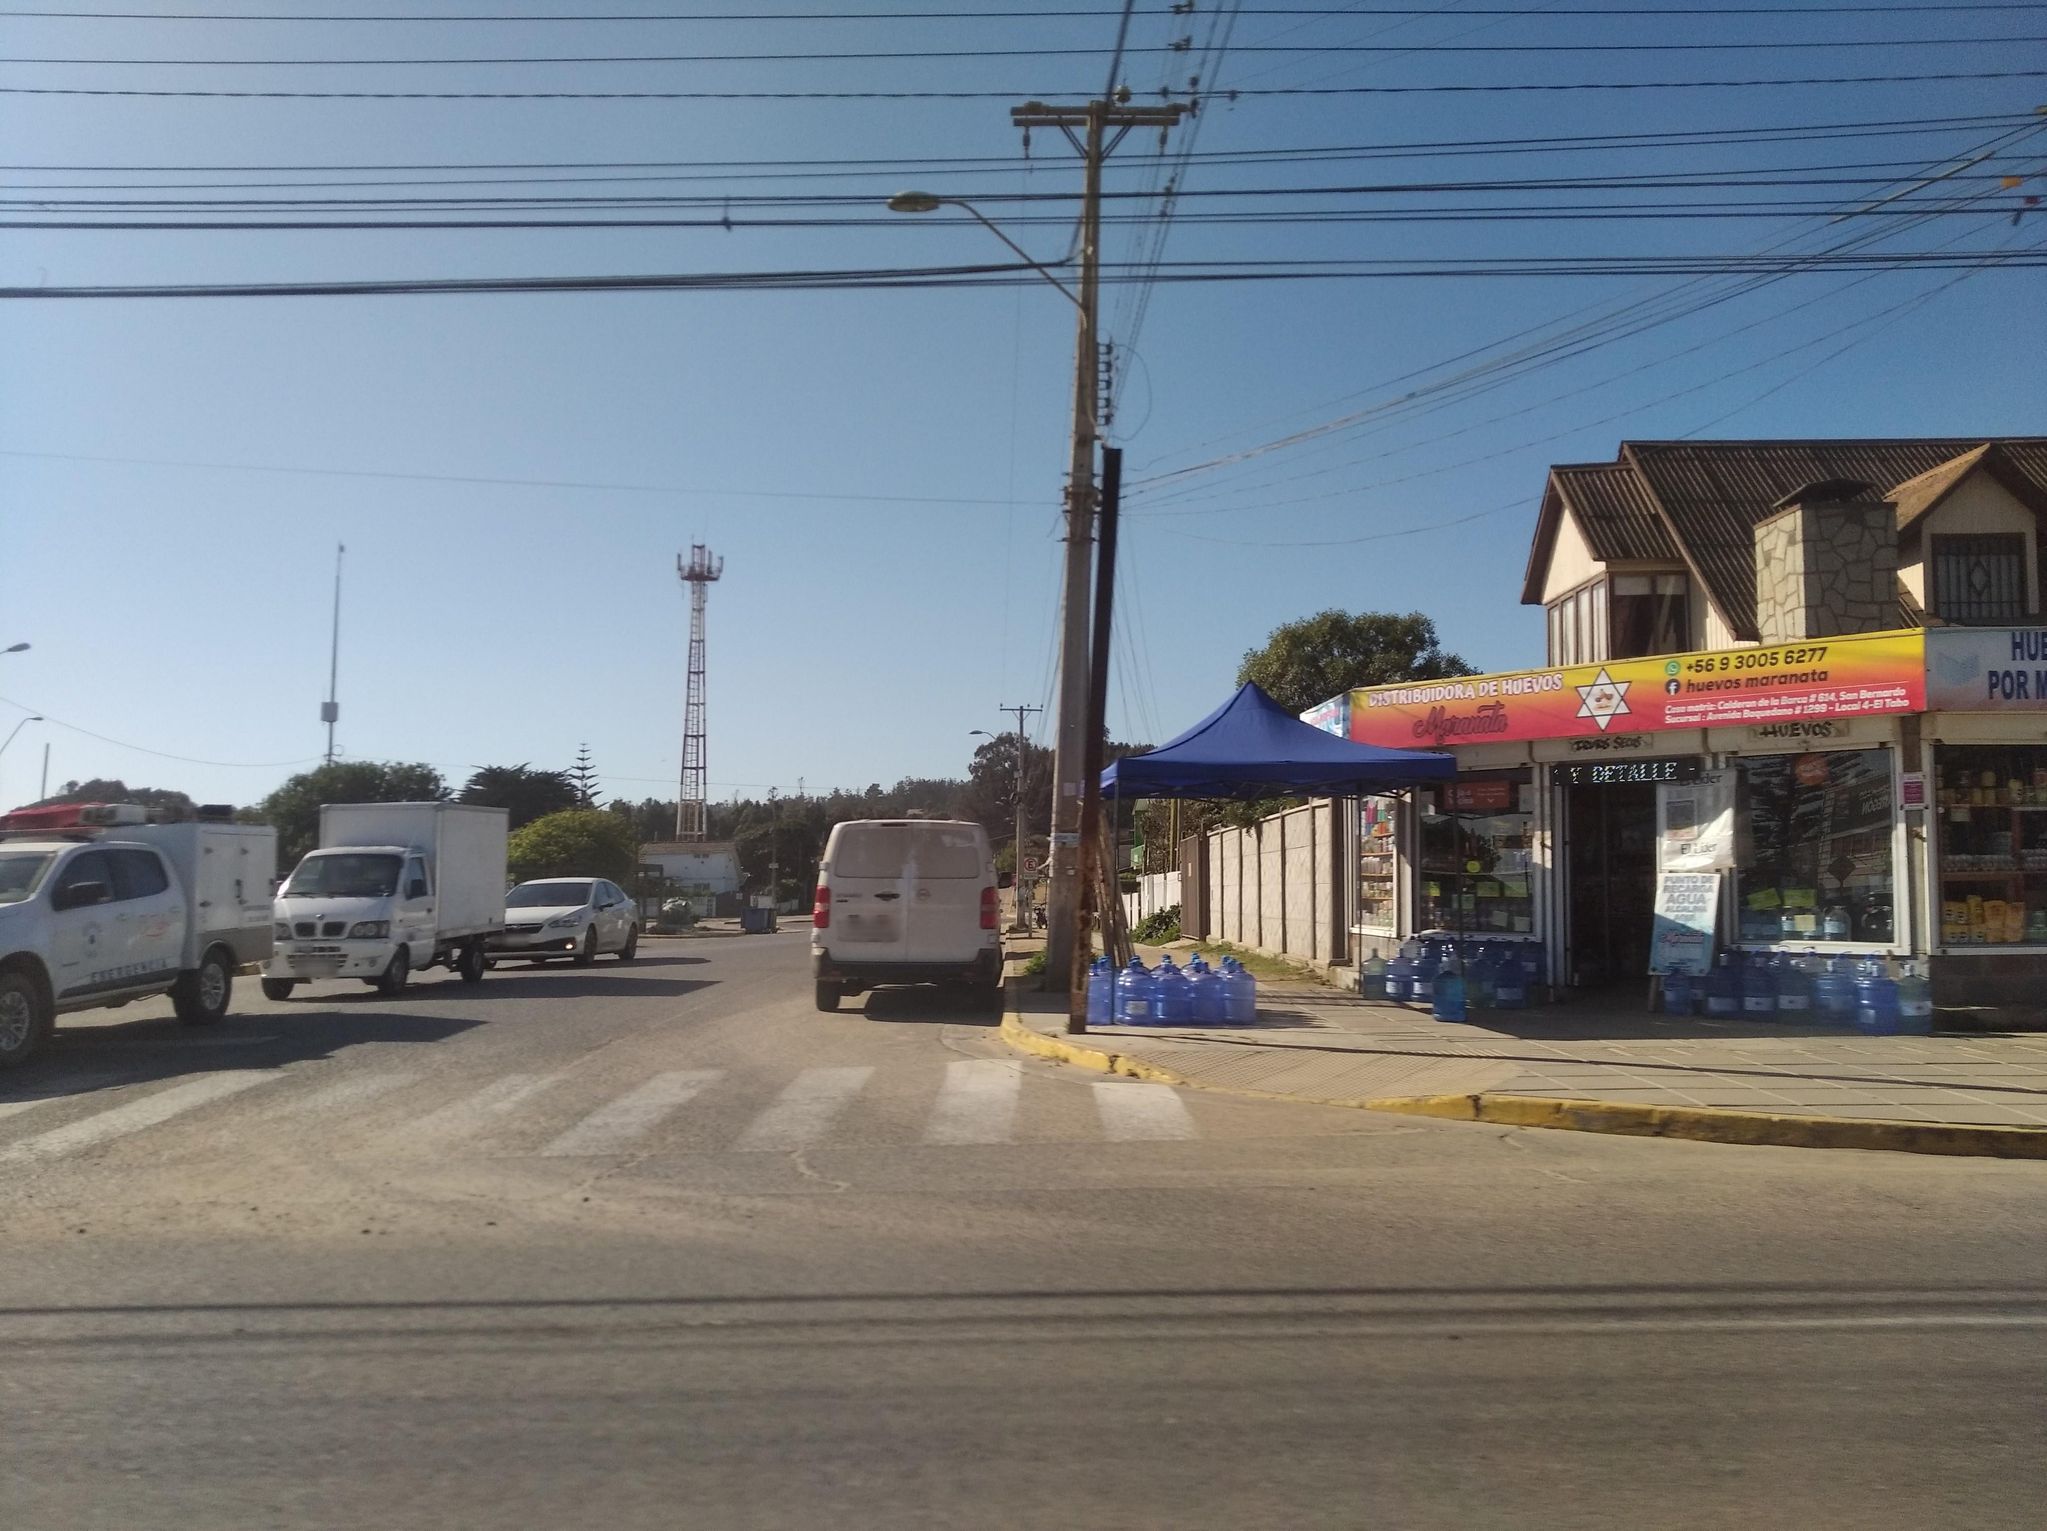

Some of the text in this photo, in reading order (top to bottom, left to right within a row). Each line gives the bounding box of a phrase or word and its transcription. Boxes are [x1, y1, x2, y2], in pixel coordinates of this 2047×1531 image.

[1686, 646, 1828, 673] +56 9 3005 6277
[1368, 673, 1563, 707] DISTRIBUIDORA DE HUEVOS
[1686, 668, 1829, 693] huevos maranata
[1988, 670, 2028, 700] POR
[1839, 691, 1858, 700] San
[1859, 686, 1906, 699] Bernardo
[1413, 700, 1508, 744] Maranata
[1759, 720, 1833, 738] HUEVOS
[1592, 762, 1678, 783] DETALLE
[1664, 875, 1713, 884] PUNTO DE
[1666, 893, 1706, 904] AGUA
